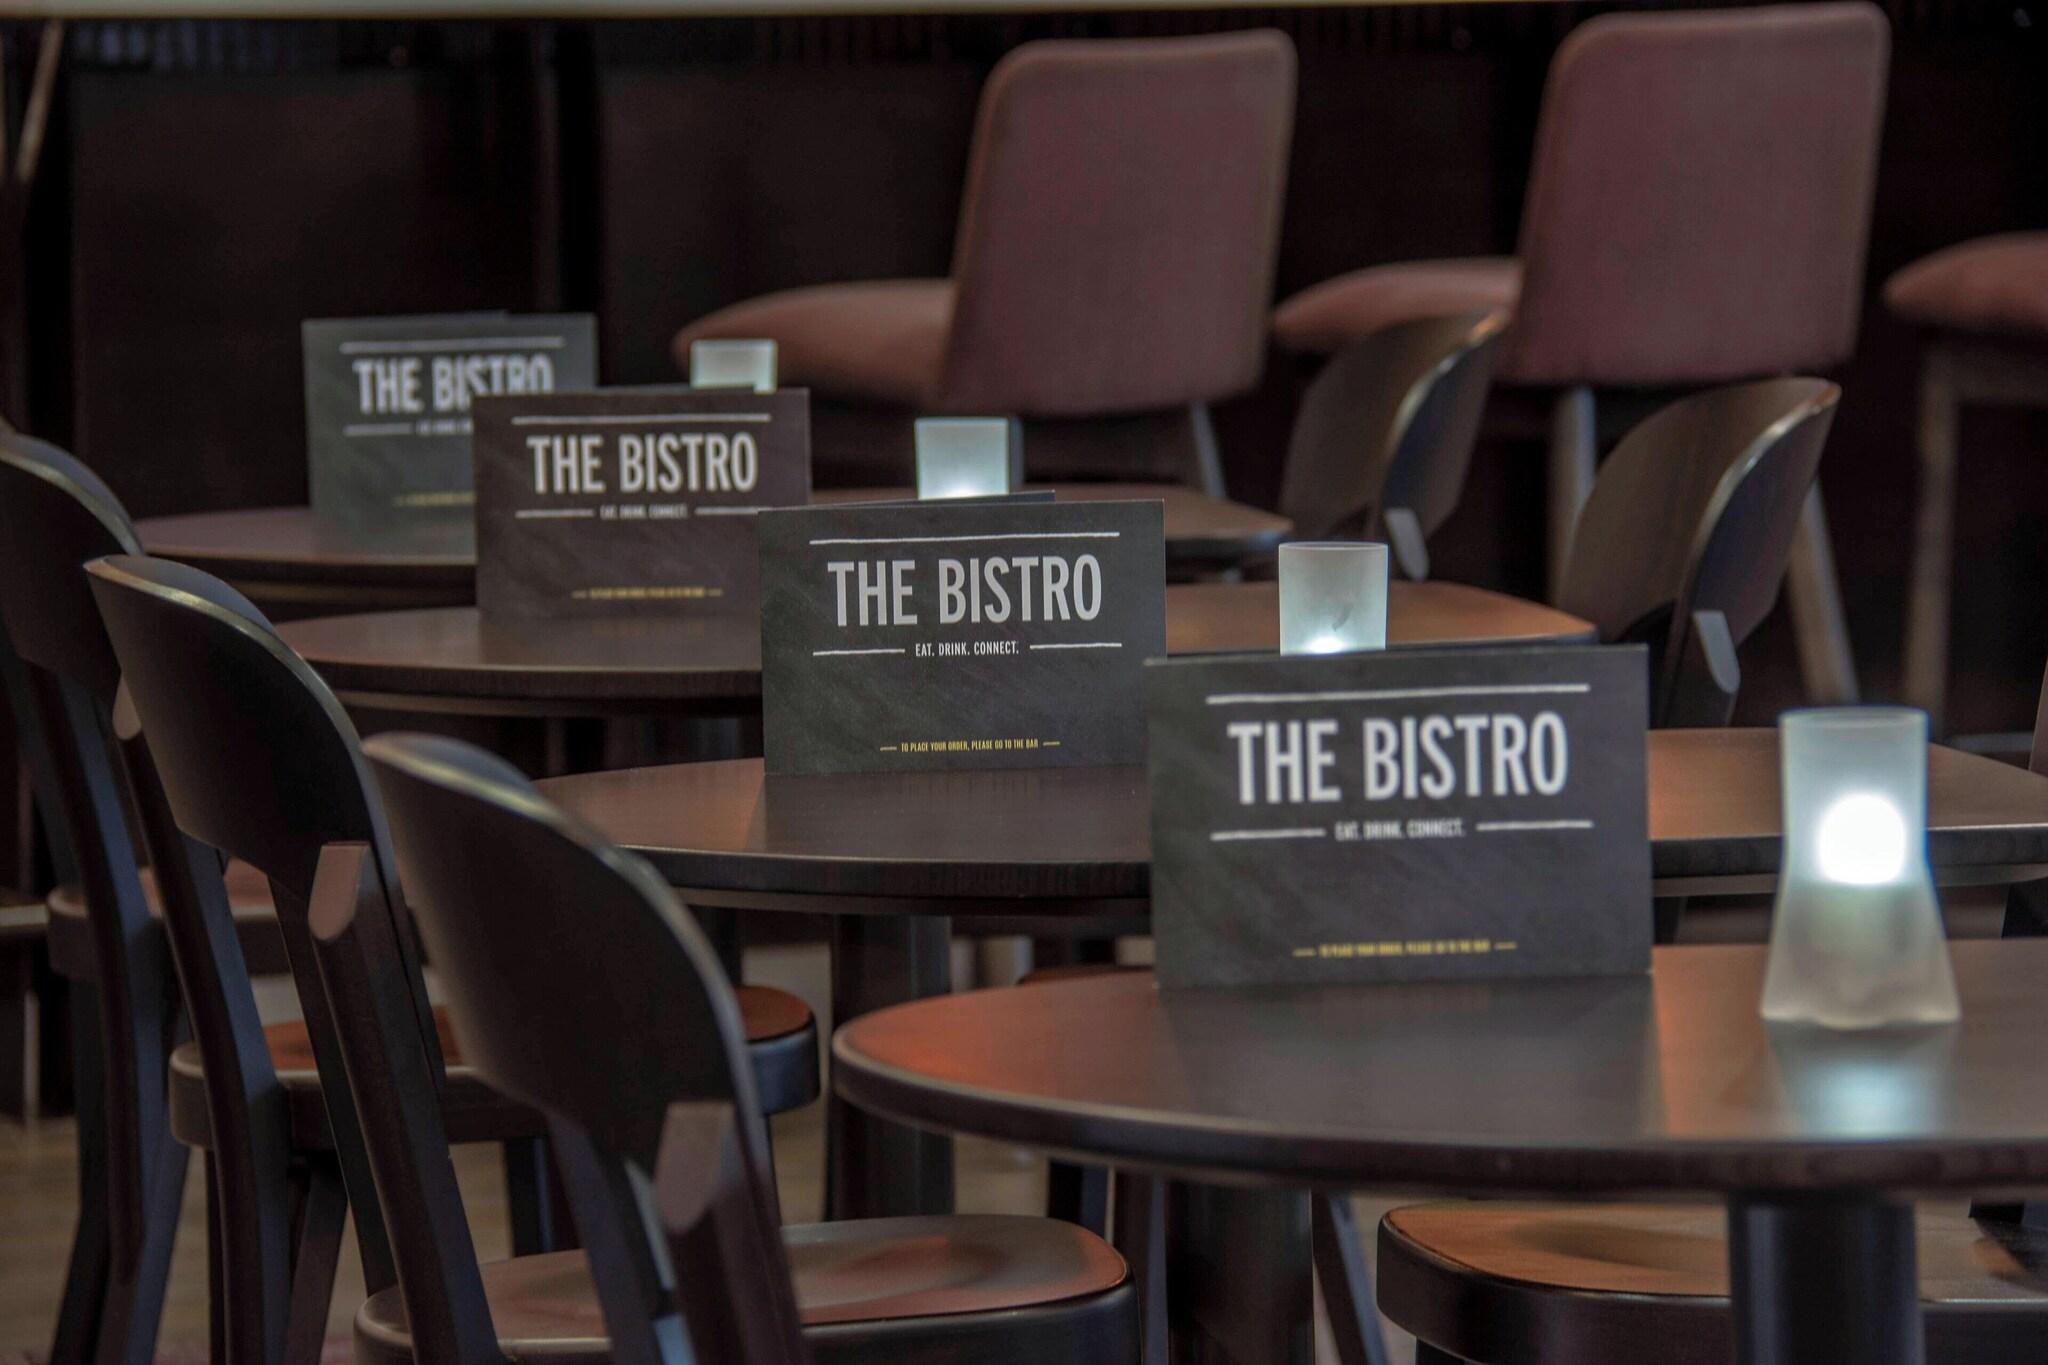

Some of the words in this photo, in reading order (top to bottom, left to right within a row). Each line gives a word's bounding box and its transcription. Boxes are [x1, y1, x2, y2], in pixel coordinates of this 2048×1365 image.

[352, 357, 424, 414] THE
[526, 436, 606, 494] THE
[618, 432, 758, 492] BISTRO
[827, 560, 918, 627] THE
[938, 554, 1102, 624] BISTRO
[915, 642, 935, 657] EAT.
[938, 641, 970, 657] DRINK.
[973, 640, 1019, 656] CONNECT.
[901, 742, 909, 753] TO
[910, 742, 929, 753] PLACE
[971, 739, 993, 751] PLEASE
[1004, 738, 1012, 750] TO
[1013, 738, 1023, 749] THE
[1227, 719, 1342, 805] THE
[1363, 711, 1570, 800] BISTRO
